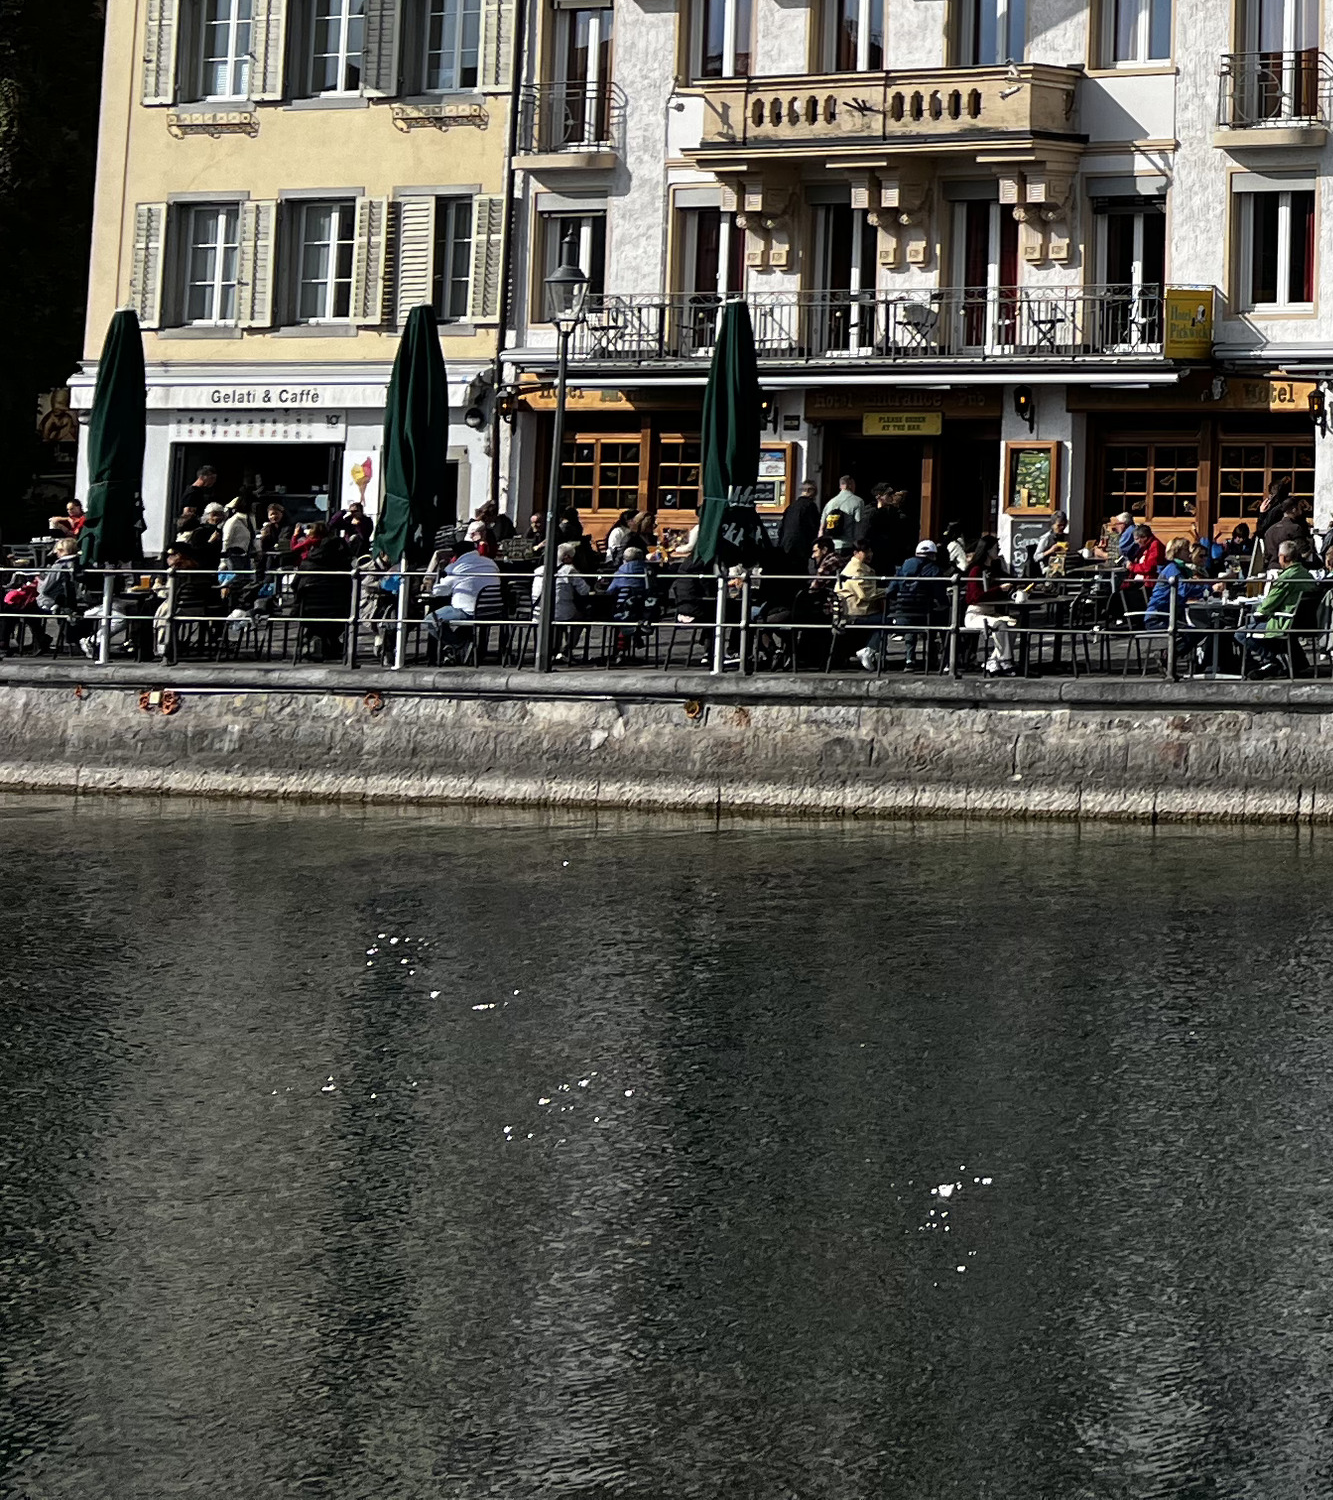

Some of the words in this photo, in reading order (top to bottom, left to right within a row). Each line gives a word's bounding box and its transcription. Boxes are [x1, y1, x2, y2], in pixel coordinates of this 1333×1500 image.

[211, 389, 256, 403] Gelati
[262, 389, 272, 403] &
[1243, 383, 1295, 404] Hotel
